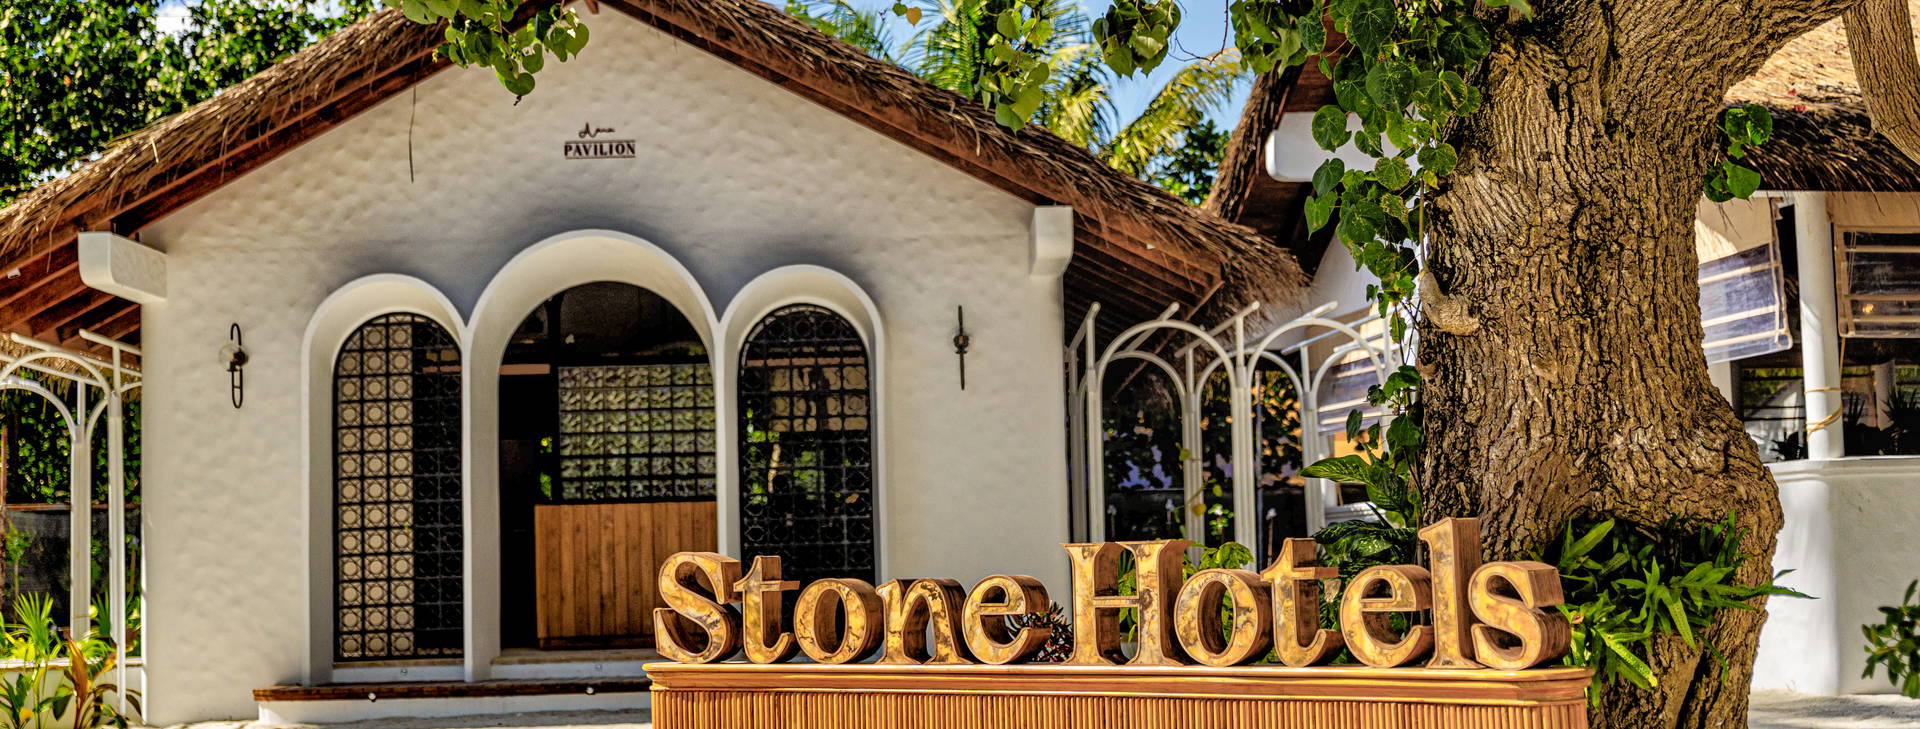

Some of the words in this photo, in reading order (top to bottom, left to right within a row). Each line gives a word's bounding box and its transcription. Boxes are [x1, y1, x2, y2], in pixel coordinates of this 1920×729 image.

[564, 143, 635, 156] PAVILION
[654, 551, 1052, 665] Stone
[1060, 517, 1572, 669] Hotels
